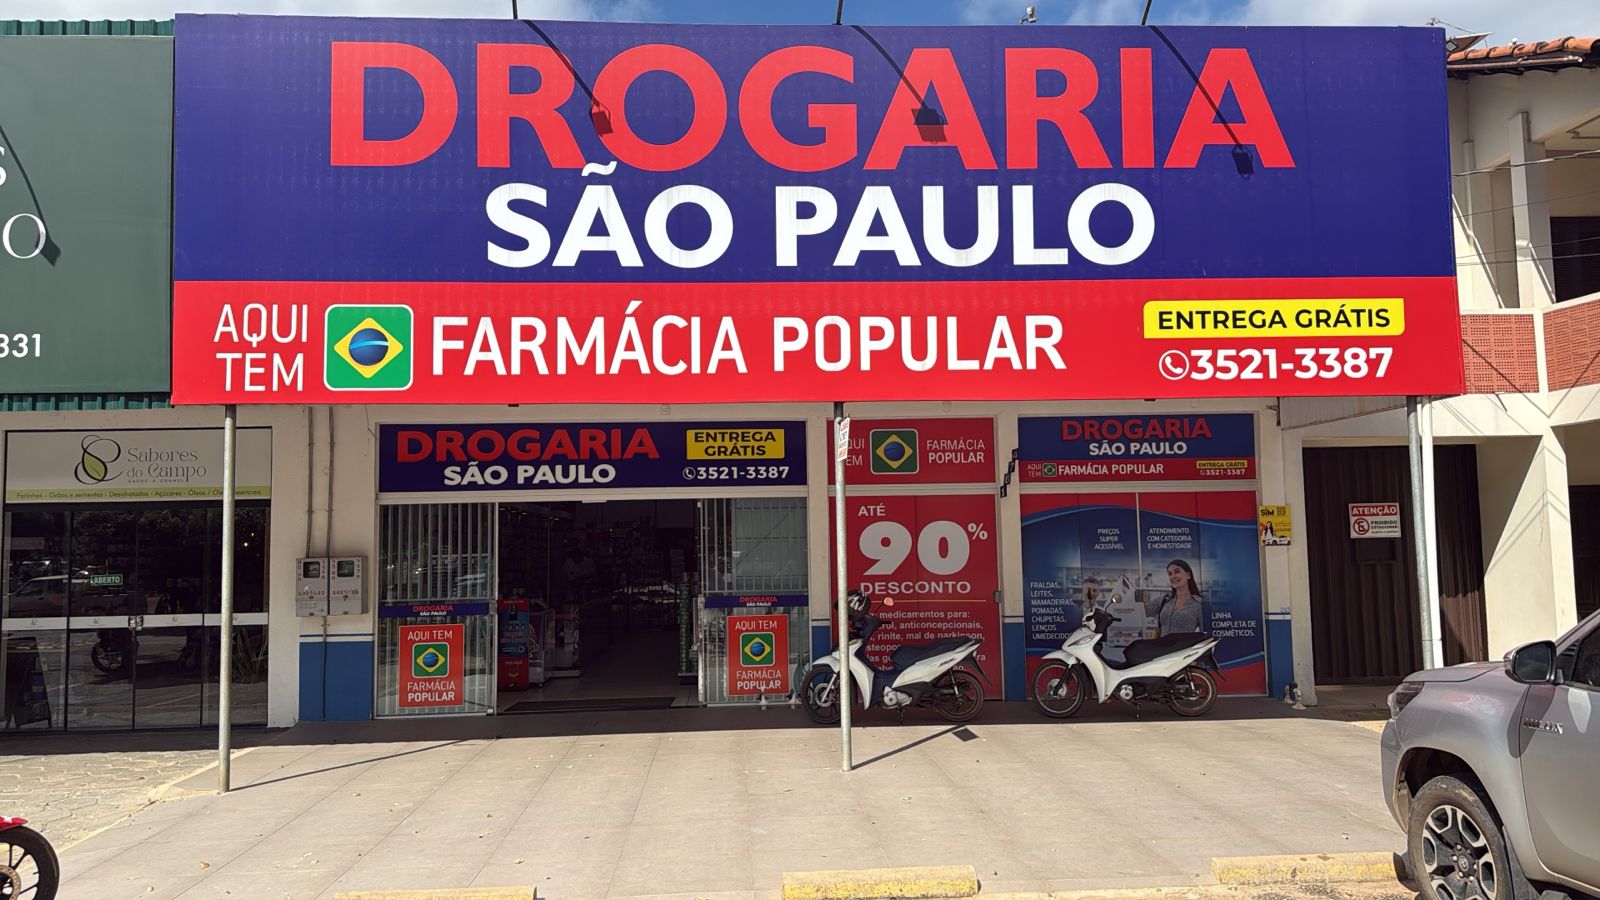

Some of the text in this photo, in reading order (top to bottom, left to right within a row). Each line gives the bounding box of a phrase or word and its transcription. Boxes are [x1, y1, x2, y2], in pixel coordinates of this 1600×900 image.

[331, 42, 1296, 171] DROGARIA
[485, 161, 1155, 268] SÃO PAULO
[1158, 304, 1390, 330] ENTREGA GRÁTIS
[213, 303, 308, 347] AQUI
[432, 300, 1067, 375] FARMÁCIA POPULAR
[1190, 347, 1393, 380] 3521-3387
[216, 352, 304, 391] TEM
[1062, 418, 1212, 440] DROGARIA
[694, 431, 777, 444] ENTREGA
[397, 428, 660, 463] DROGARIA
[704, 440, 767, 457] GRÁTIS
[848, 438, 865, 450] QUI
[926, 437, 985, 451] FARMÁCIA
[1089, 439, 1187, 456] SÃO PAULO
[127, 448, 198, 463] Sabores
[846, 455, 864, 466] EM
[928, 452, 984, 464] POPULAR
[126, 463, 207, 482] do Campo
[697, 465, 790, 480] 3521-3387
[1027, 463, 1041, 471] AQUI
[1058, 462, 1164, 475] FARMÁCIA POPULAR
[444, 461, 616, 486] SÃO PAULO
[858, 503, 886, 517] ATÉ
[1352, 505, 1397, 516] ATENÇÃO
[1098, 528, 1120, 536] PREÇOS
[1094, 542, 1125, 550] ACESSÍVEL
[94, 576, 121, 584] ABERTO
[1030, 581, 1060, 589] FRALDAS,
[860, 581, 971, 595] DESCONTO
[412, 604, 454, 612] DROGARIA
[1031, 607, 1065, 615] POMADAS,
[880, 610, 945, 619] medicamentos
[947, 611, 970, 620] para:
[1031, 615, 1067, 623] CHUPETAS,
[735, 620, 778, 631] AQUI TEM
[899, 620, 984, 630] anticoncepcionais,
[1032, 624, 1057, 632] LENÇOS
[1211, 620, 1257, 628] COMPLETA DE
[407, 630, 453, 641] AQUI TEM
[878, 631, 904, 641] rinite,
[906, 631, 921, 639] mal
[924, 631, 935, 639] de
[1032, 632, 1072, 640] UMEDECIDO
[1212, 627, 1256, 637] COSMÉTICOS.
[736, 668, 782, 680] FARMÁCIA
[407, 679, 456, 692] FARMÁCIA
[737, 680, 782, 690] POPULAR
[408, 691, 455, 702] POPULAR
